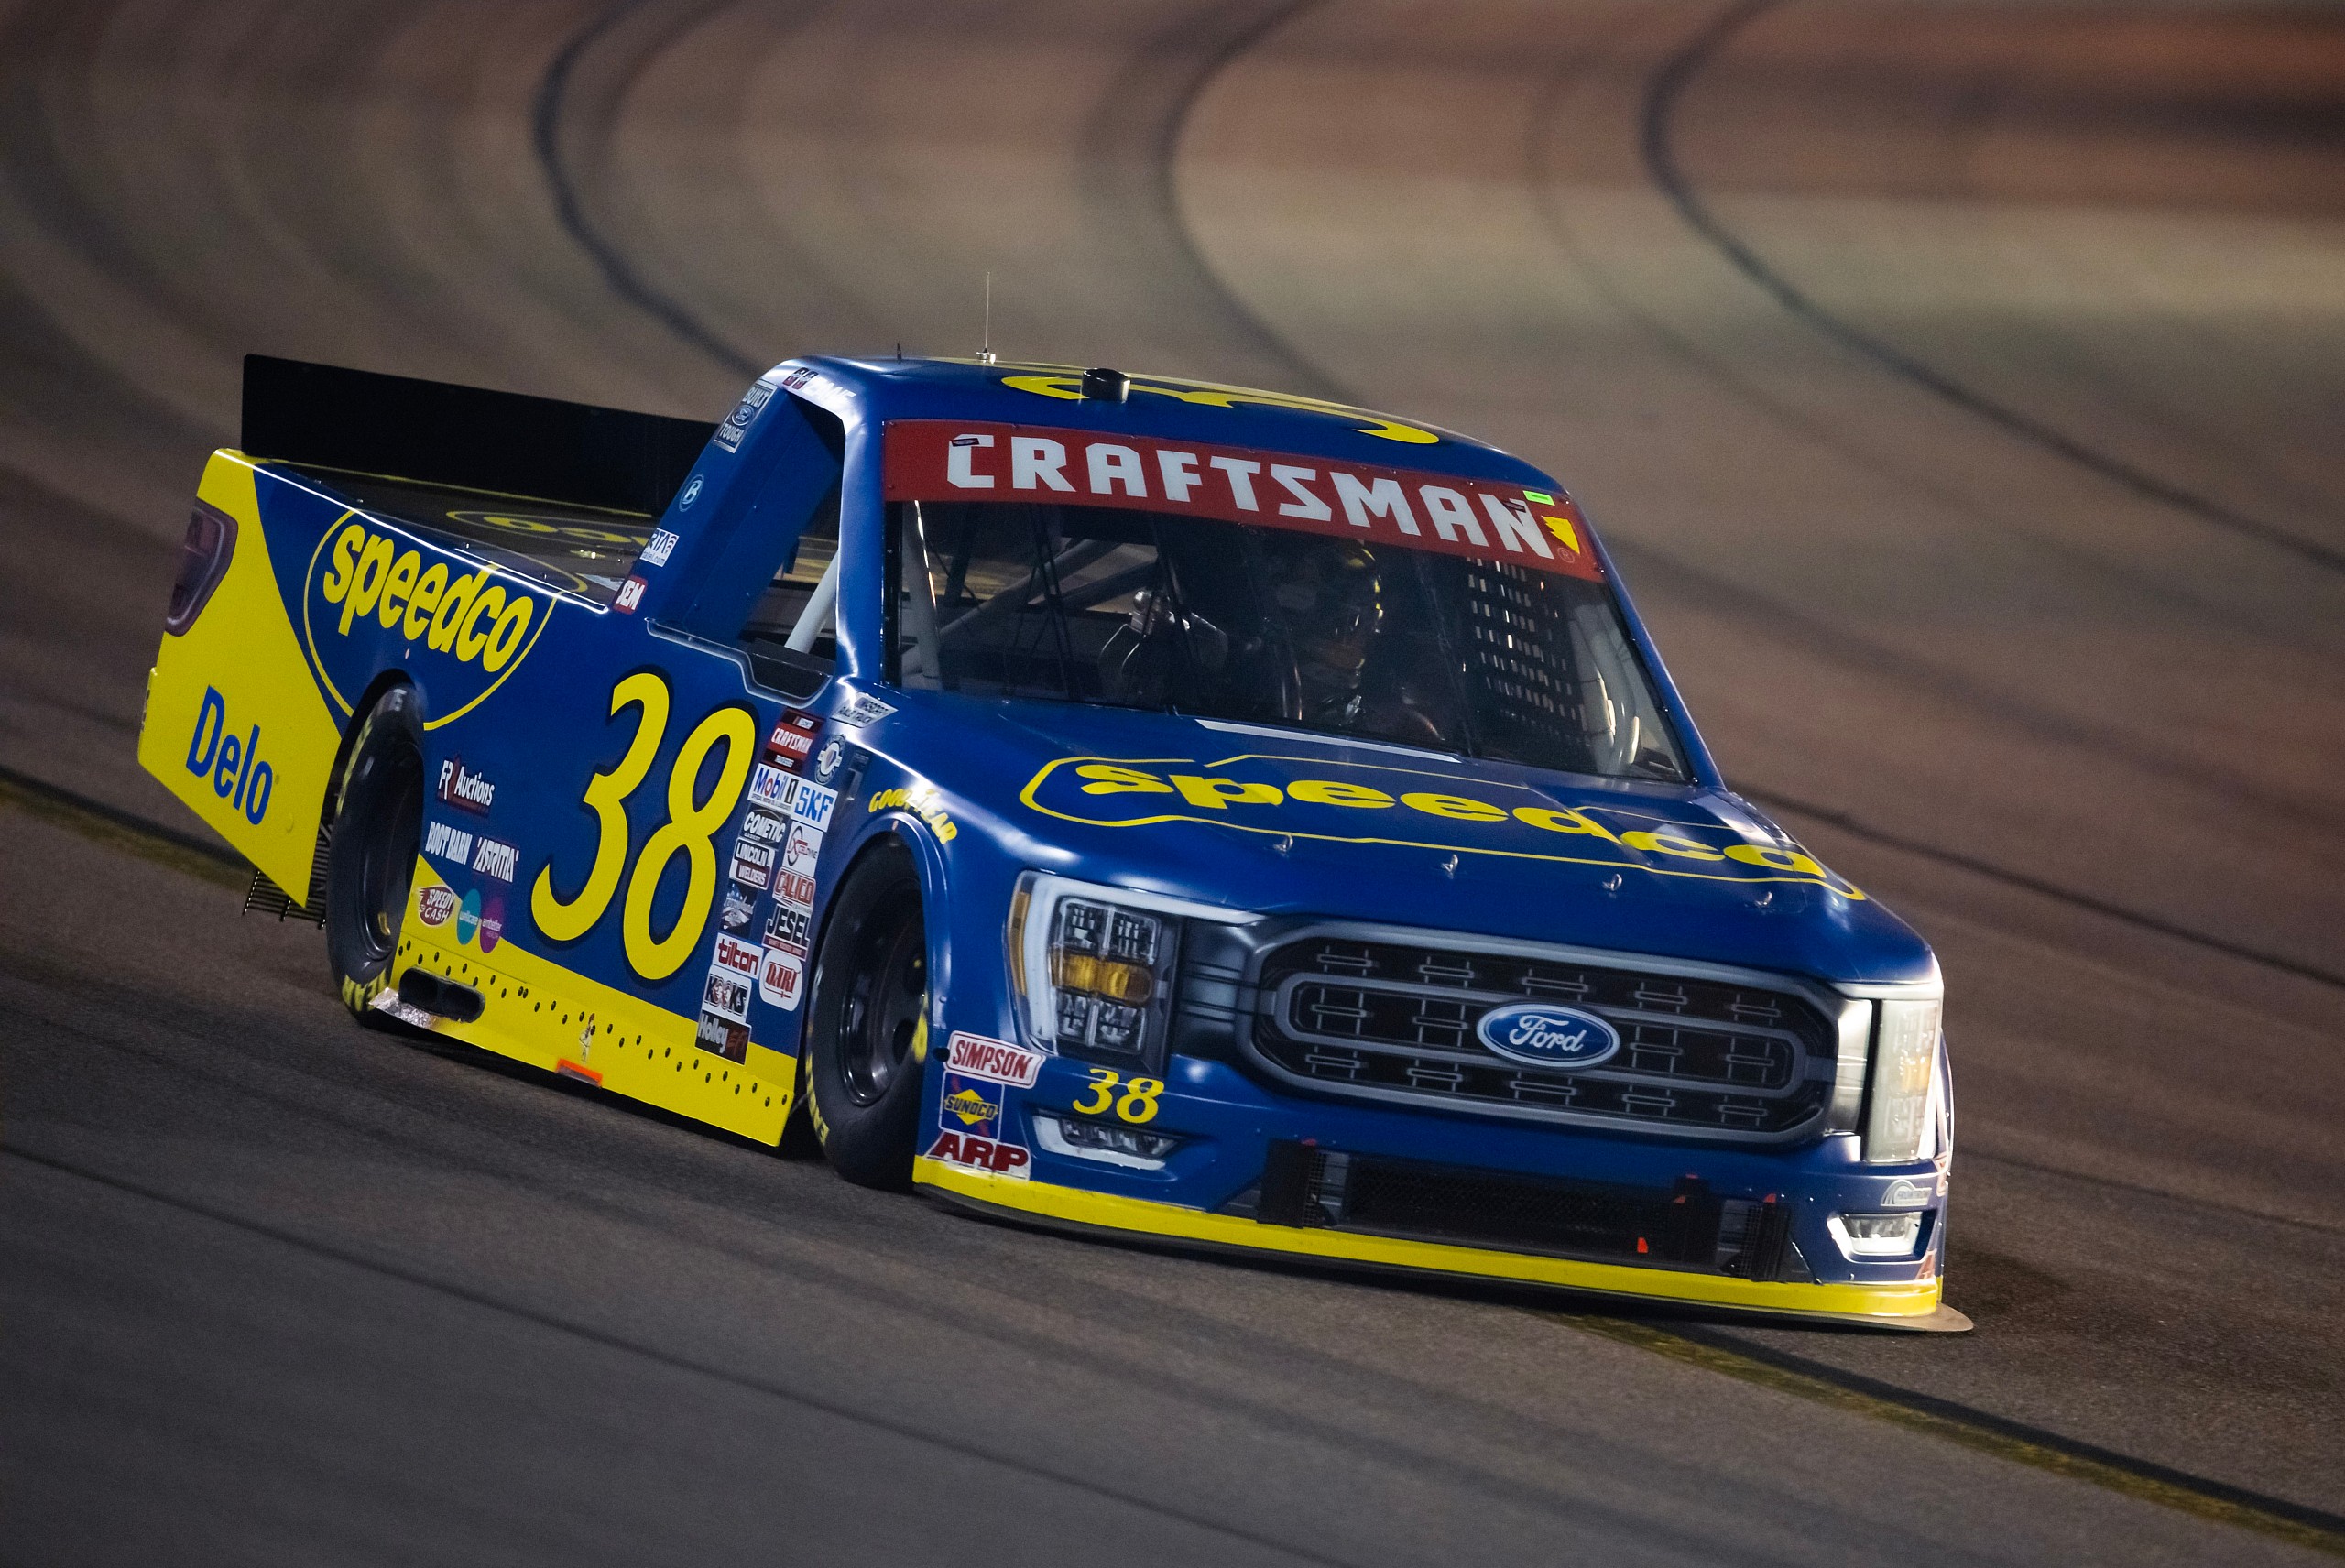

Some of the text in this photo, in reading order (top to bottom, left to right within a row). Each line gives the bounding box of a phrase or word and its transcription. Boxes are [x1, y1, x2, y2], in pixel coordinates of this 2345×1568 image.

[947, 433, 1555, 560] CRAFTSMAN
[323, 523, 534, 673] speedco
[616, 579, 645, 611] SEM
[185, 684, 273, 826] Delo
[771, 727, 813, 754] CRAFTSMAN
[453, 766, 496, 807] Auctions
[753, 768, 788, 801] Mobil
[794, 786, 834, 822] SKF
[531, 672, 756, 980] 38
[743, 811, 786, 843] COMETIC
[1075, 764, 1828, 879] speedco
[425, 821, 473, 866] BOOT BARN
[736, 840, 769, 867] LINCOLN
[738, 863, 768, 886] WELDERS
[775, 871, 814, 905] CALICO
[424, 907, 449, 921] CASH
[426, 888, 455, 910] SPEEDY
[766, 904, 811, 948] JESEL
[697, 1012, 729, 1054] Holley
[1508, 1014, 1588, 1052] Ford
[952, 1039, 1034, 1080] SIMPSON
[943, 1094, 998, 1121] SUNOCO
[1072, 1067, 1165, 1125] 38
[929, 1131, 1029, 1172] ARP
